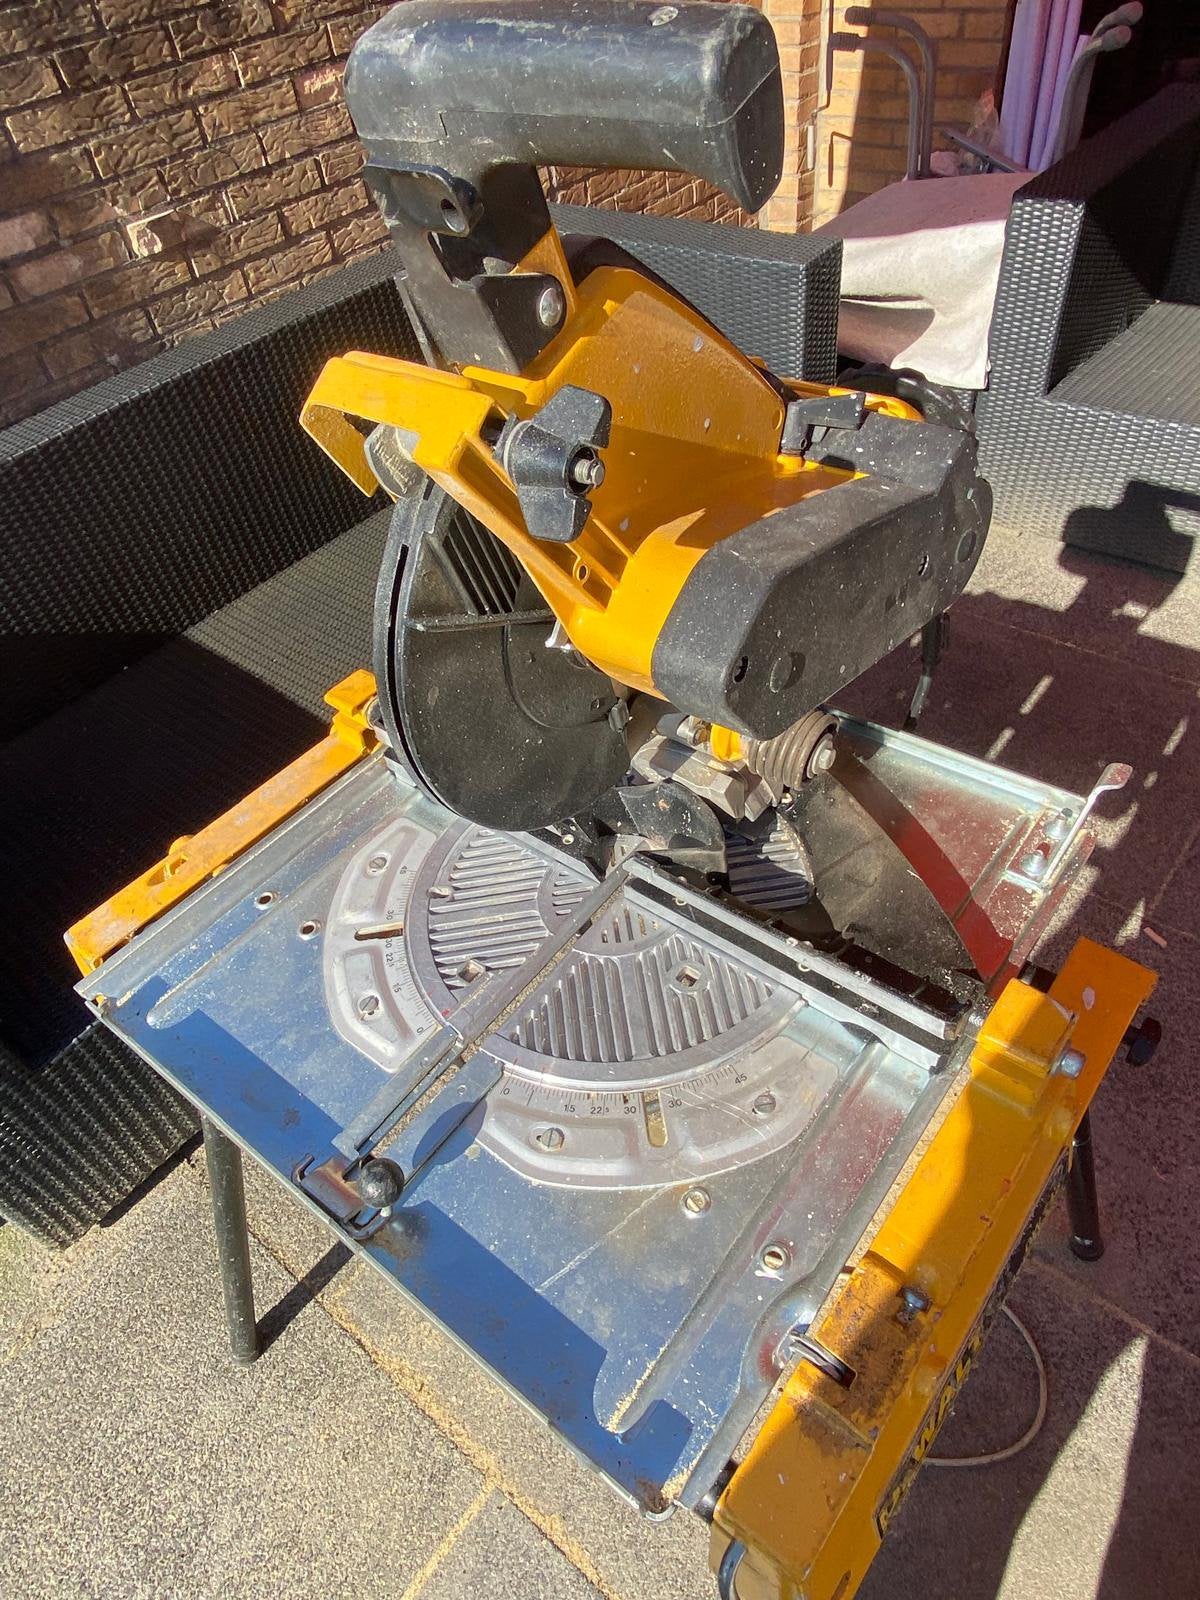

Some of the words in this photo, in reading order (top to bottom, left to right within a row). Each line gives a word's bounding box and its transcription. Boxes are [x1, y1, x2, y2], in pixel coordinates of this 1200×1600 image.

[385, 938, 393, 949] 30
[392, 982, 402, 994] 15
[416, 1026, 424, 1034] 0
[734, 1073, 748, 1085] 45
[503, 1087, 511, 1096] 0
[563, 1104, 576, 1113] 15
[623, 1105, 637, 1115] 30
[668, 1098, 683, 1109] 30
